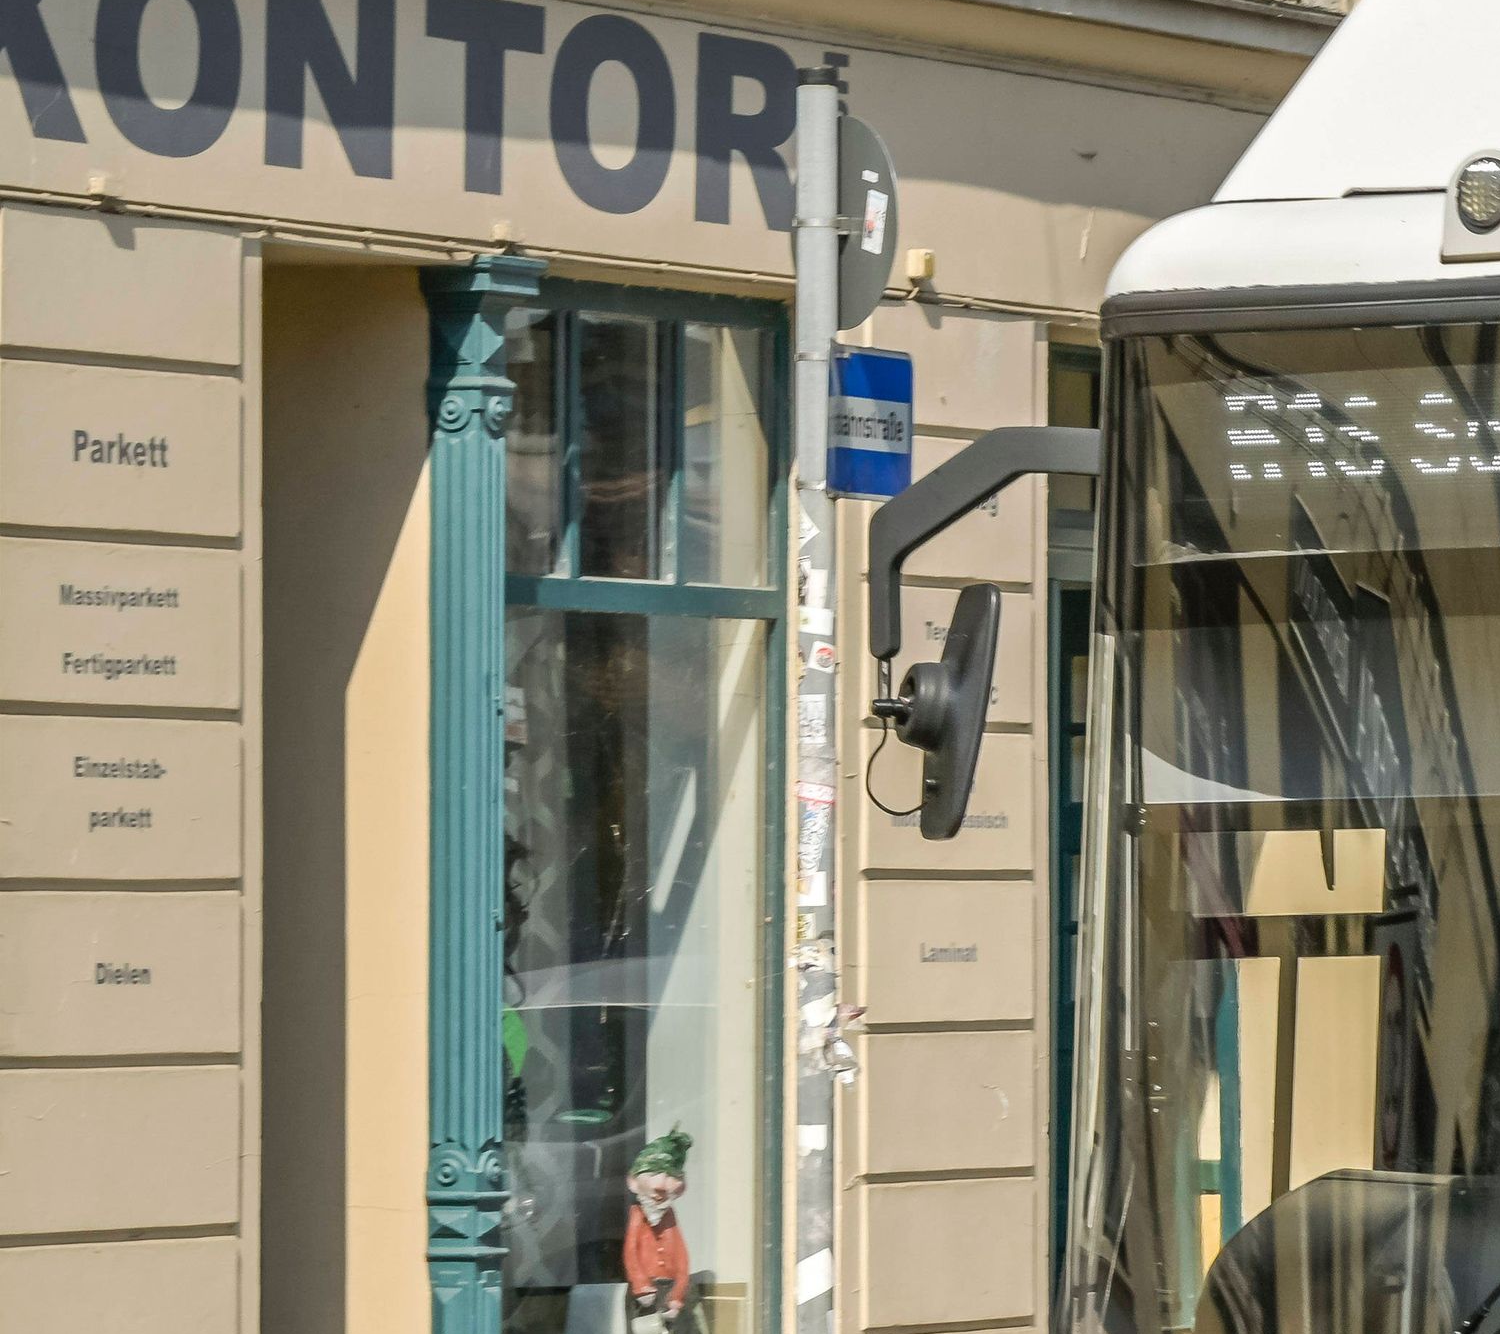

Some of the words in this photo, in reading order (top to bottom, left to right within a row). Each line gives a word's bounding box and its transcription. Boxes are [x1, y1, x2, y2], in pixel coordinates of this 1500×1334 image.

[73, 430, 169, 468] Parkett
[59, 584, 180, 612] Massivparkett
[62, 652, 177, 681] Fertigparkett
[89, 807, 153, 832] parkett
[920, 942, 978, 964] Laminat
[95, 961, 152, 985] Dielen
